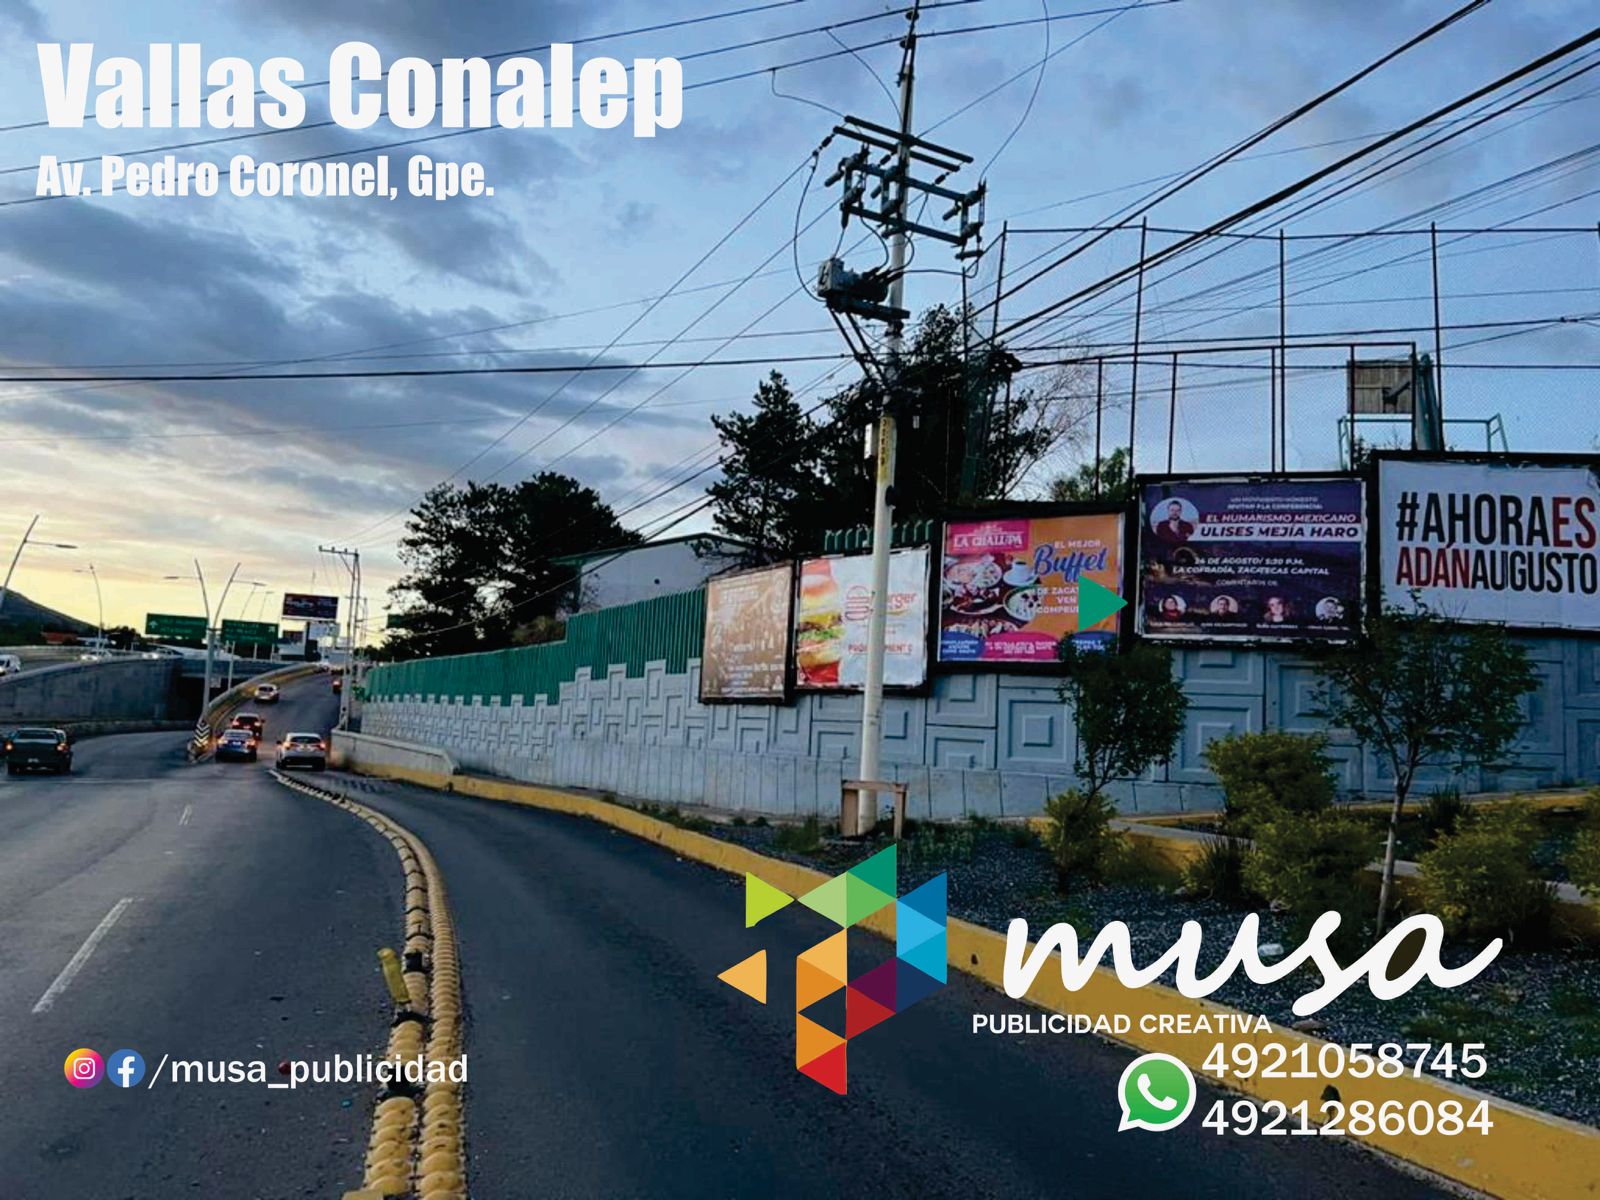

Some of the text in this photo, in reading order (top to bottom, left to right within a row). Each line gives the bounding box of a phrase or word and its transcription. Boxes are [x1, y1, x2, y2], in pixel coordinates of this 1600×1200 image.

[1206, 514, 1357, 523] EL HUMANISMO MEXICANO
[1396, 492, 1597, 549] #AHORAES
[1201, 523, 1359, 538] ULISES MEJÍA HARO
[953, 534, 968, 548] LA
[1054, 540, 1101, 549] EL MEJOR
[1034, 544, 1107, 582] Buffet
[1172, 565, 1184, 574] LA
[1238, 566, 1288, 574] ZACATECAS
